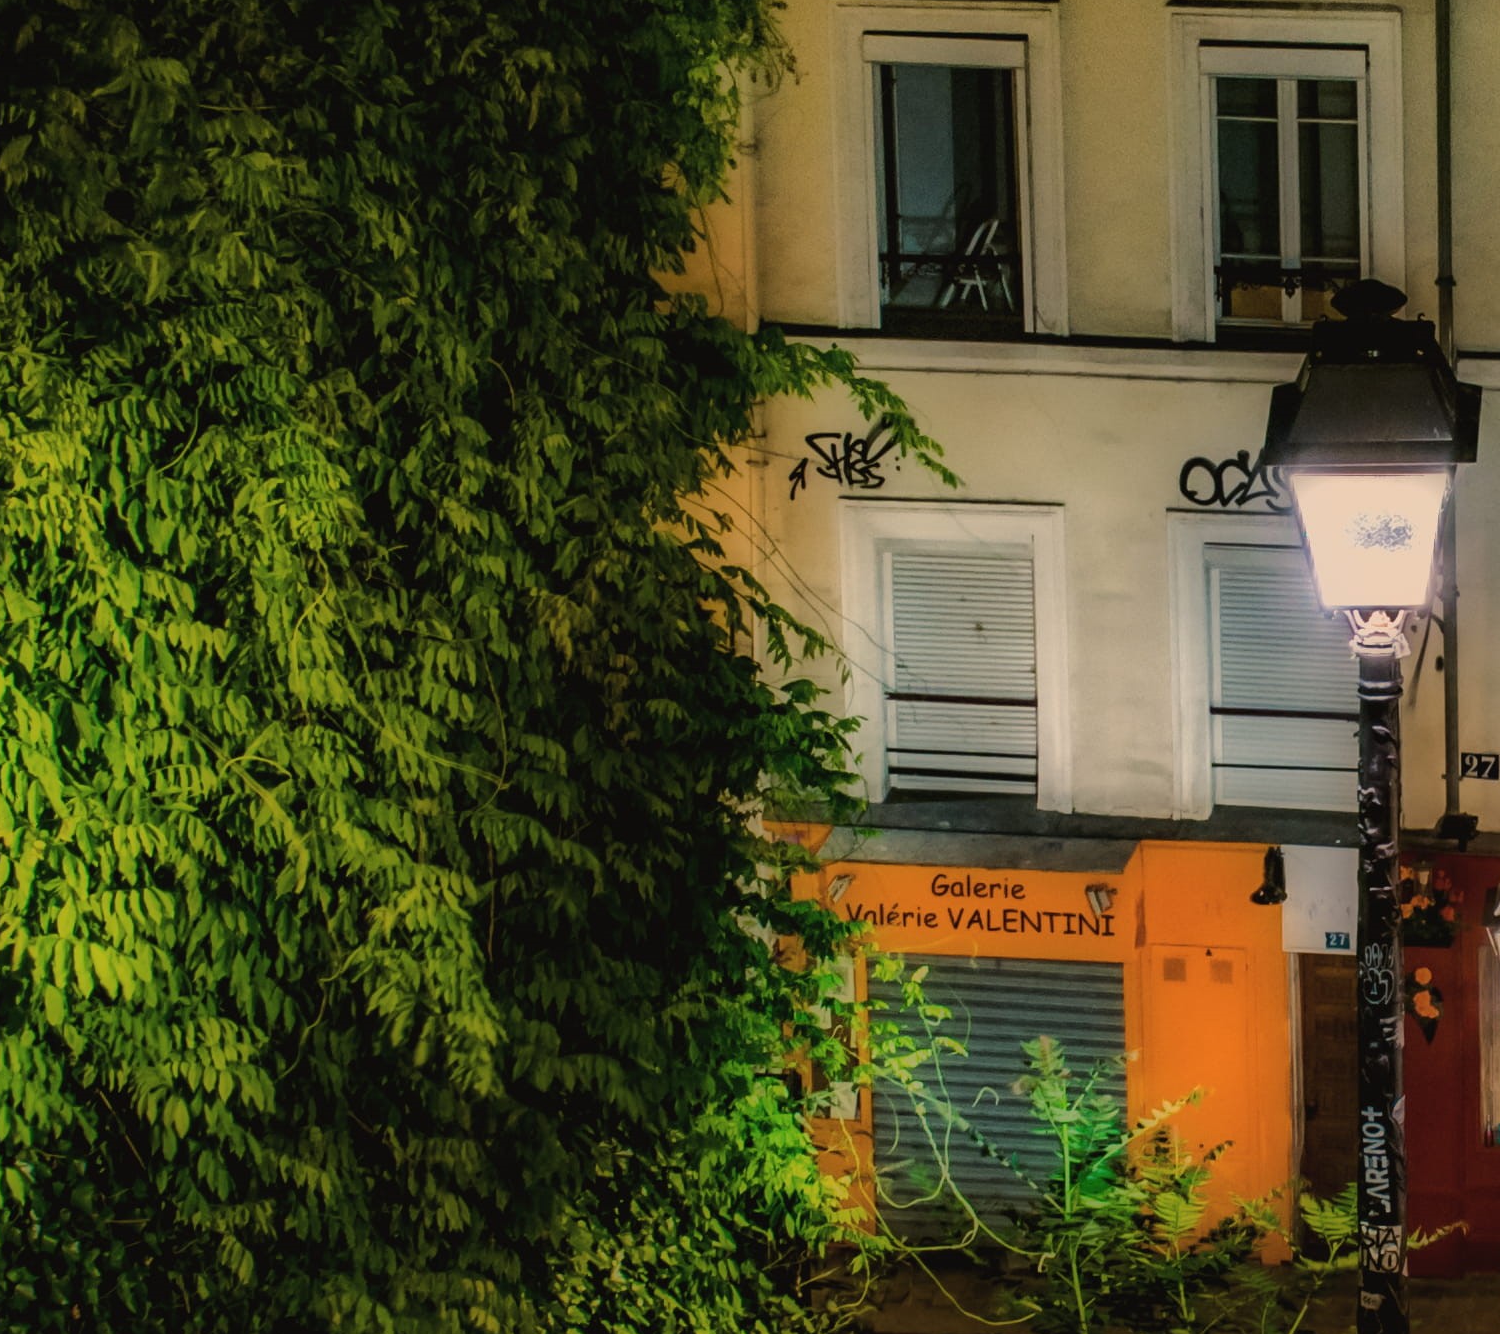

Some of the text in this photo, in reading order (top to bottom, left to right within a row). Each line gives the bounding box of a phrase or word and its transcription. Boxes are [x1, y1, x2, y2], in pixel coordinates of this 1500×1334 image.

[1464, 754, 1496, 778] 27
[930, 873, 1026, 900] Galerie
[846, 902, 1116, 937] Valérie VALENTINI
[1329, 933, 1346, 947] 27
